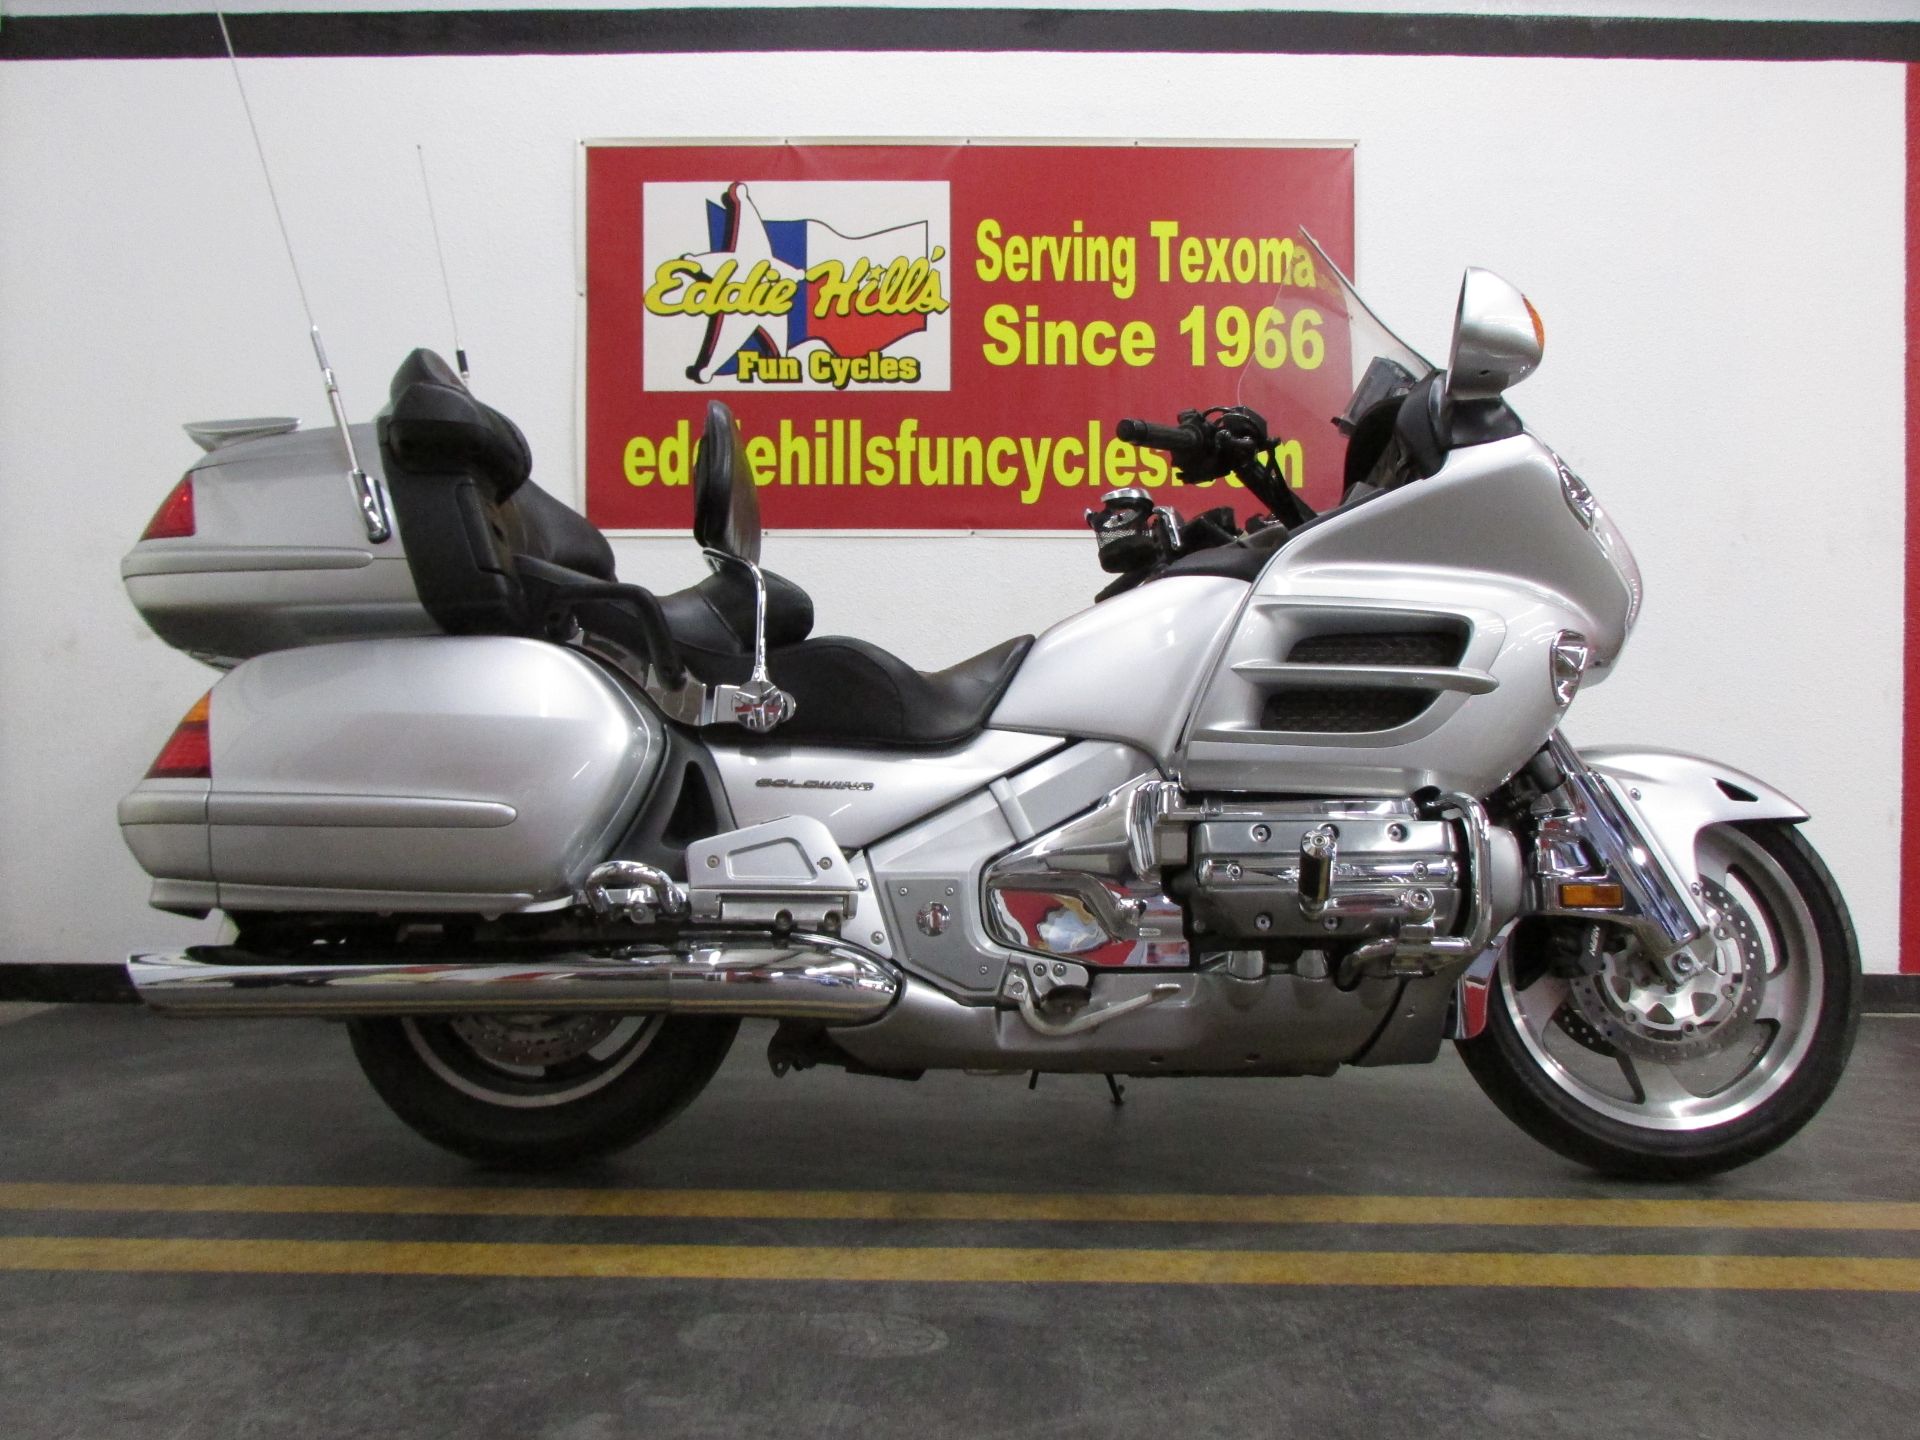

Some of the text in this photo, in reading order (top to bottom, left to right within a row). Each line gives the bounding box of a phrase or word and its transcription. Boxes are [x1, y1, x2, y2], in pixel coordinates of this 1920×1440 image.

[644, 245, 950, 318] Eddie Hill's
[975, 218, 1316, 300] Serving Texoma
[737, 350, 921, 389] Fun Cycles
[982, 303, 1325, 370] Since 1966
[623, 418, 1304, 505] edehillsfuncycles.m
